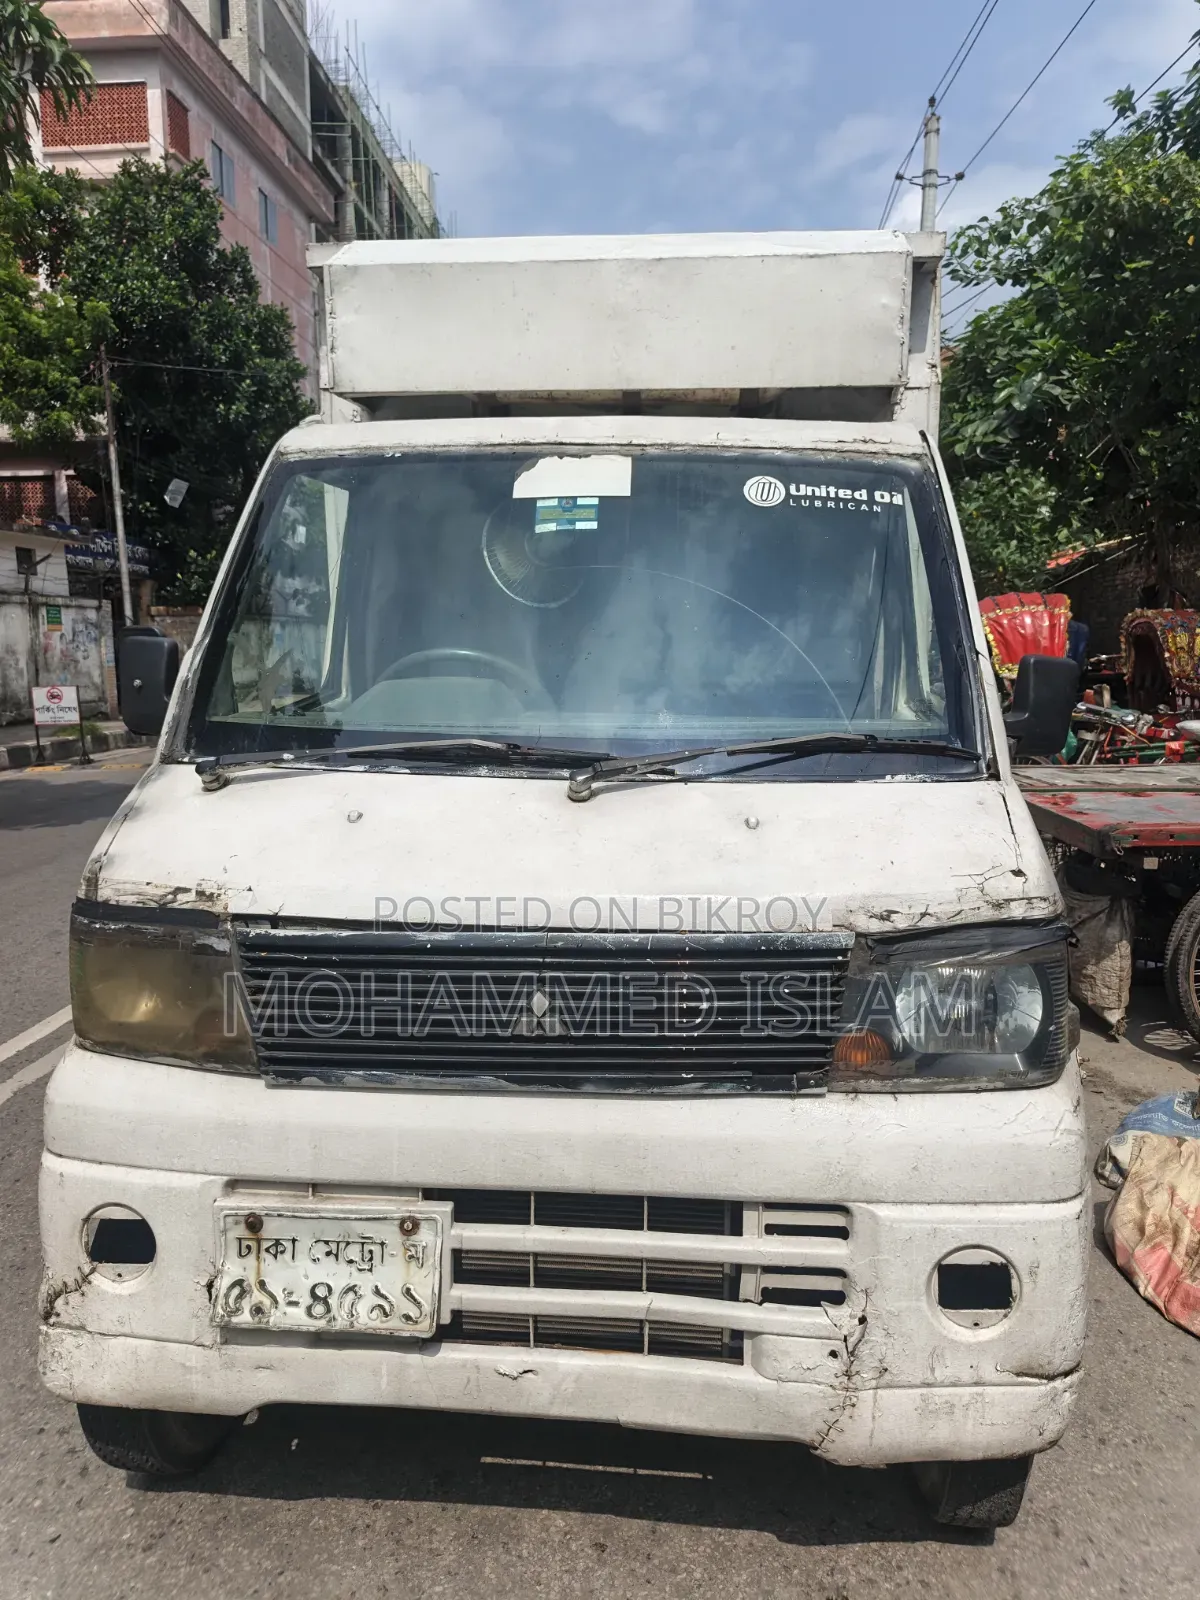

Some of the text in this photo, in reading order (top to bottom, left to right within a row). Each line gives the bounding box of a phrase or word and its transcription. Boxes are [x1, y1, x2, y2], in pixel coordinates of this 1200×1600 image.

[789, 483, 868, 501] United
[789, 499, 882, 513] LUBRICAN
[235, 1235, 299, 1263] ঢাকা
